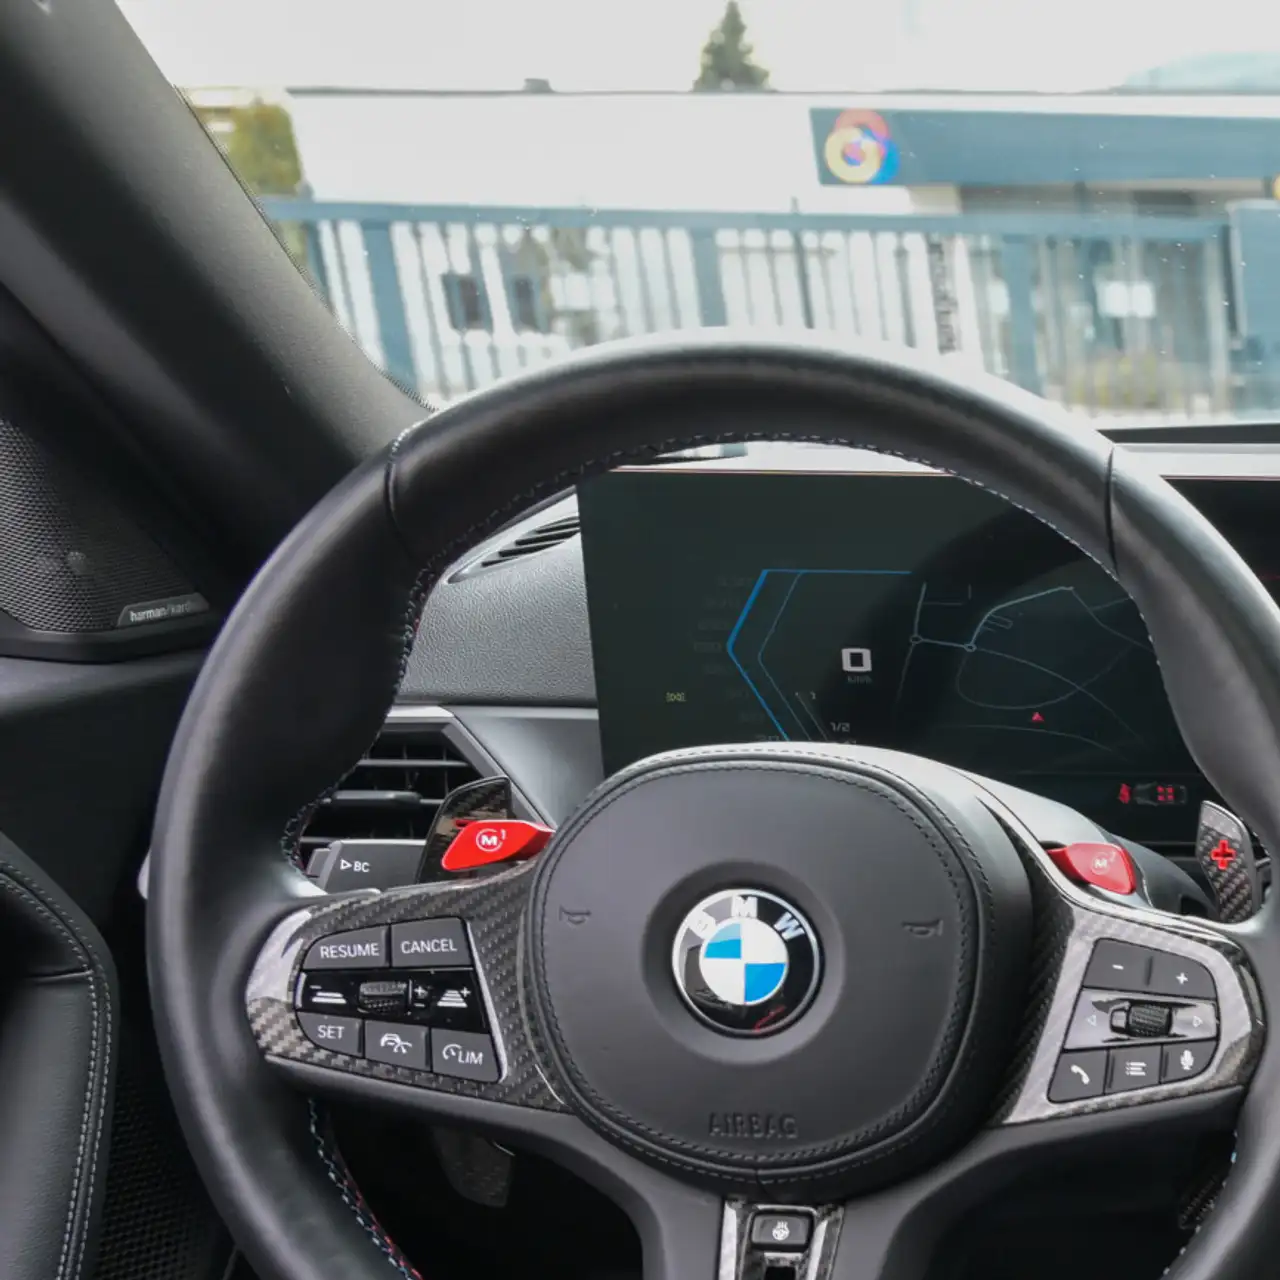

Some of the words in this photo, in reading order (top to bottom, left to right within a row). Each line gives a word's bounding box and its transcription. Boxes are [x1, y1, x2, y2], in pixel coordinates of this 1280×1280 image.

[841, 648, 872, 672] 0
[353, 861, 371, 873] BC
[687, 894, 805, 941] BMW
[320, 943, 380, 959] RESUME
[401, 939, 458, 954] CANCEL
[318, 1024, 345, 1040] SET
[458, 1050, 484, 1065] LIM
[708, 1111, 799, 1139] AIRBAG
